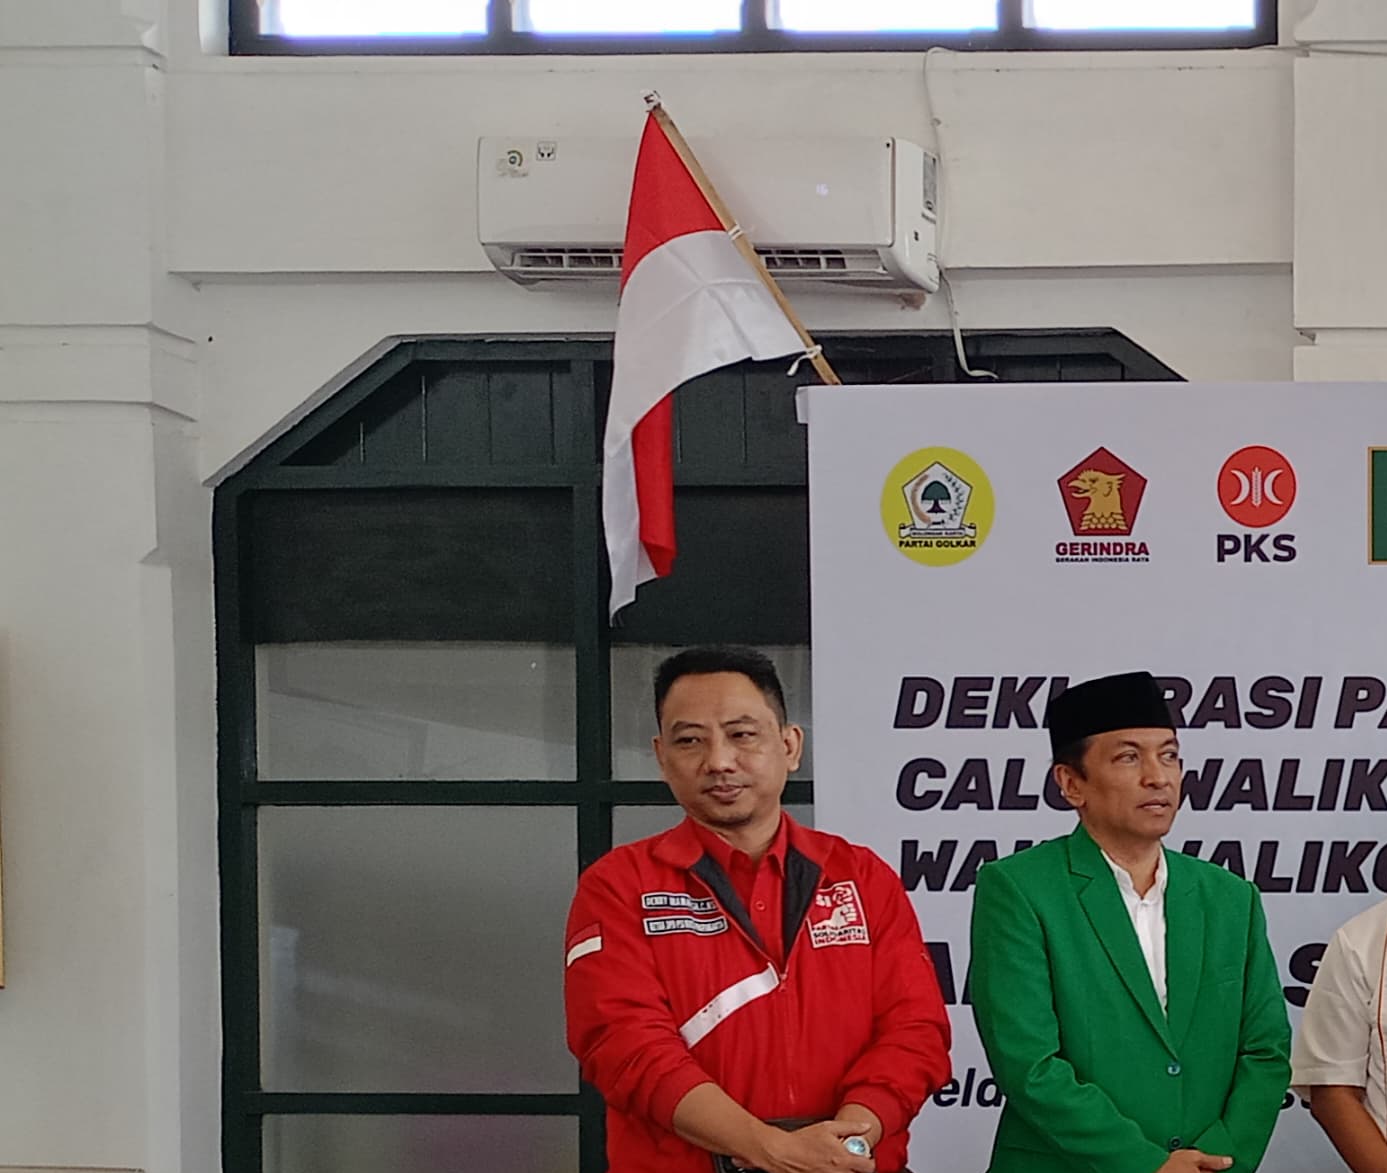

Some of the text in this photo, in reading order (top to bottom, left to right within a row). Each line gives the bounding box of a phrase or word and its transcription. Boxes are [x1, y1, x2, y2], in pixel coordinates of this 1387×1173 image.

[899, 540, 977, 548] PARTAI GOLKAR
[1055, 542, 1150, 556] GERINDRA
[1216, 534, 1297, 563] PKS
[893, 676, 1322, 730] DEKRASI
